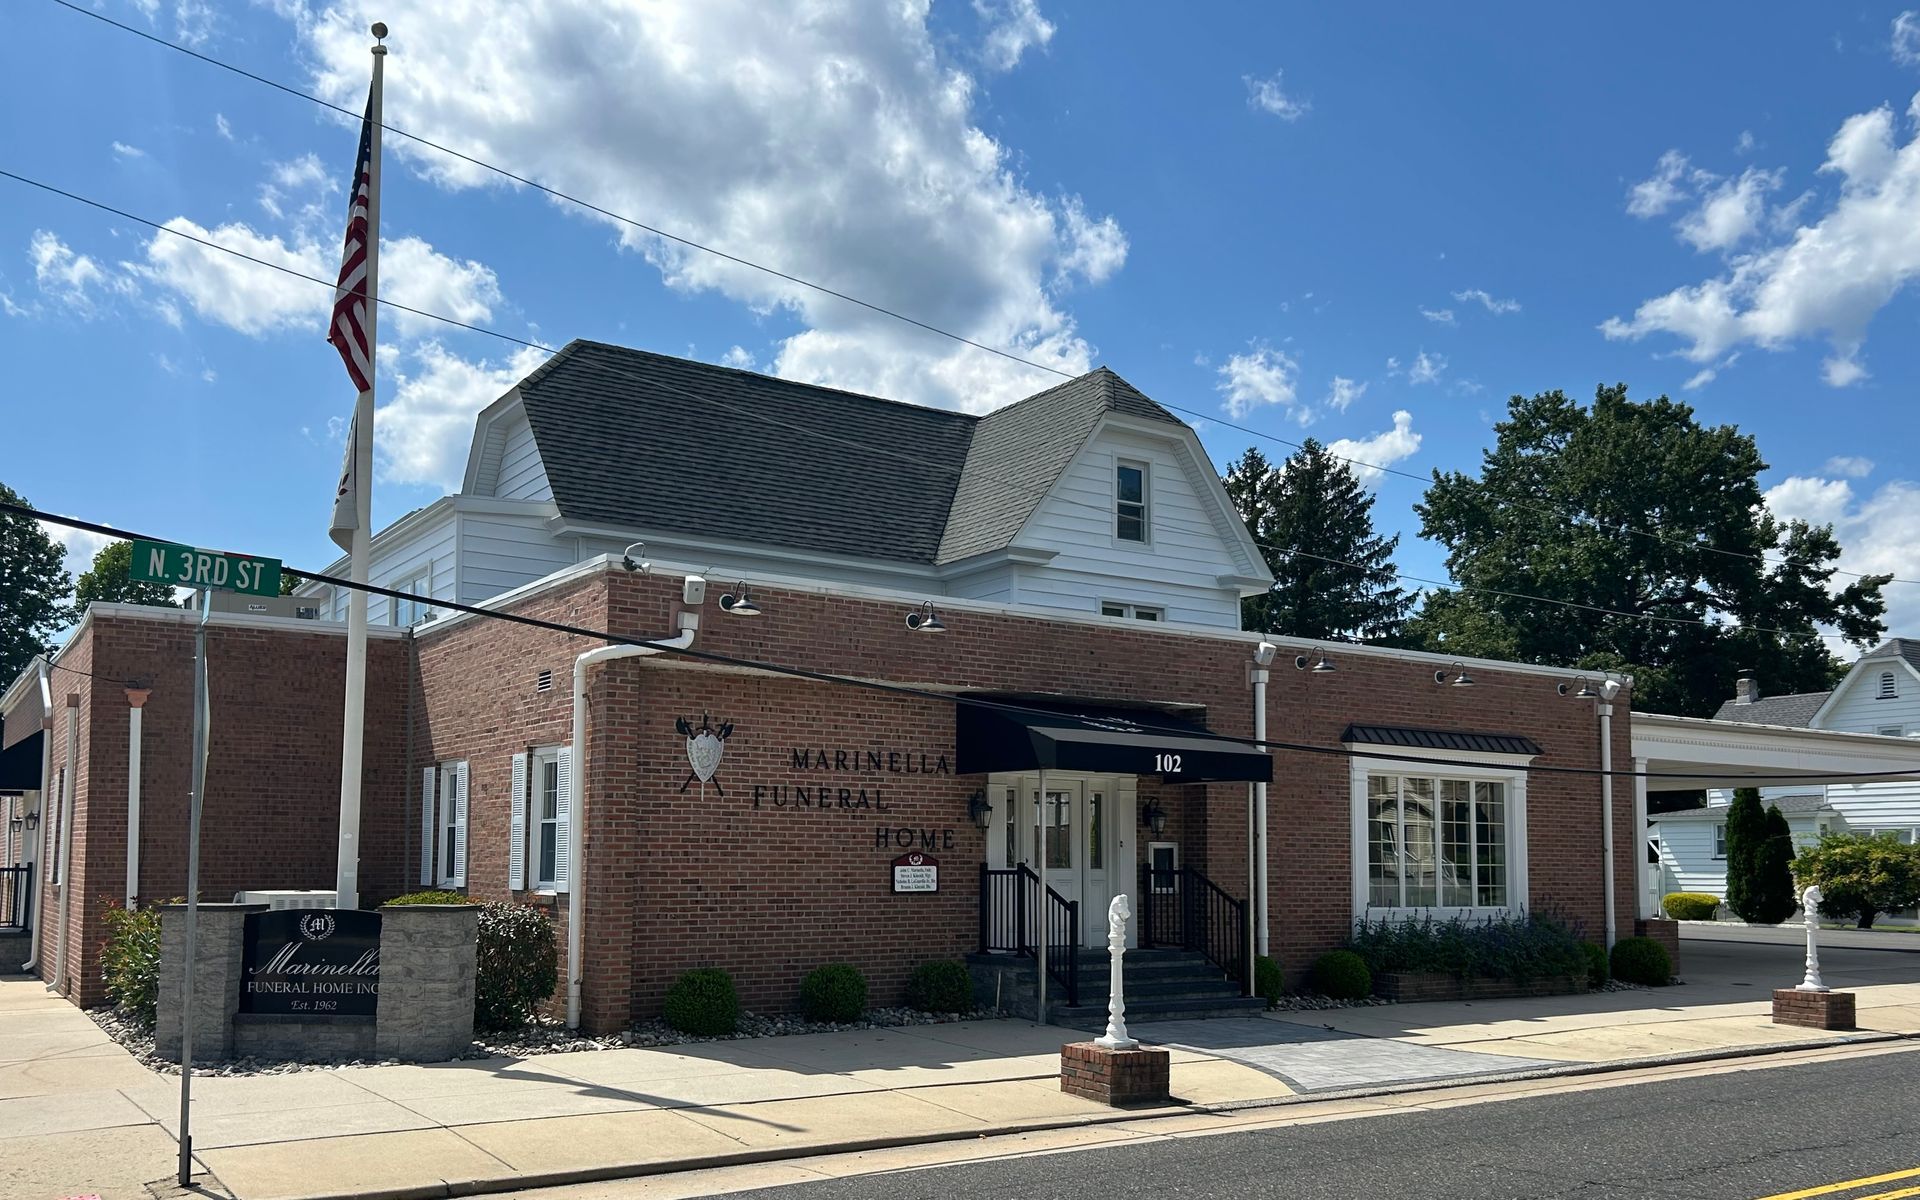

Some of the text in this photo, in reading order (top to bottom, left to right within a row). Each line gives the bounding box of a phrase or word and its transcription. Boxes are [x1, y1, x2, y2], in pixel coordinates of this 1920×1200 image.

[148, 548, 265, 590] N. 3RD ST
[792, 747, 950, 775] MARINELLA
[1154, 753, 1182, 773] 102
[753, 785, 889, 810] FUNERAL
[876, 827, 955, 849] HOME
[248, 941, 381, 976] Marinella
[247, 981, 310, 994] FUNERAL
[313, 982, 353, 994] HOME
[291, 1000, 337, 1010] Est. 1962
